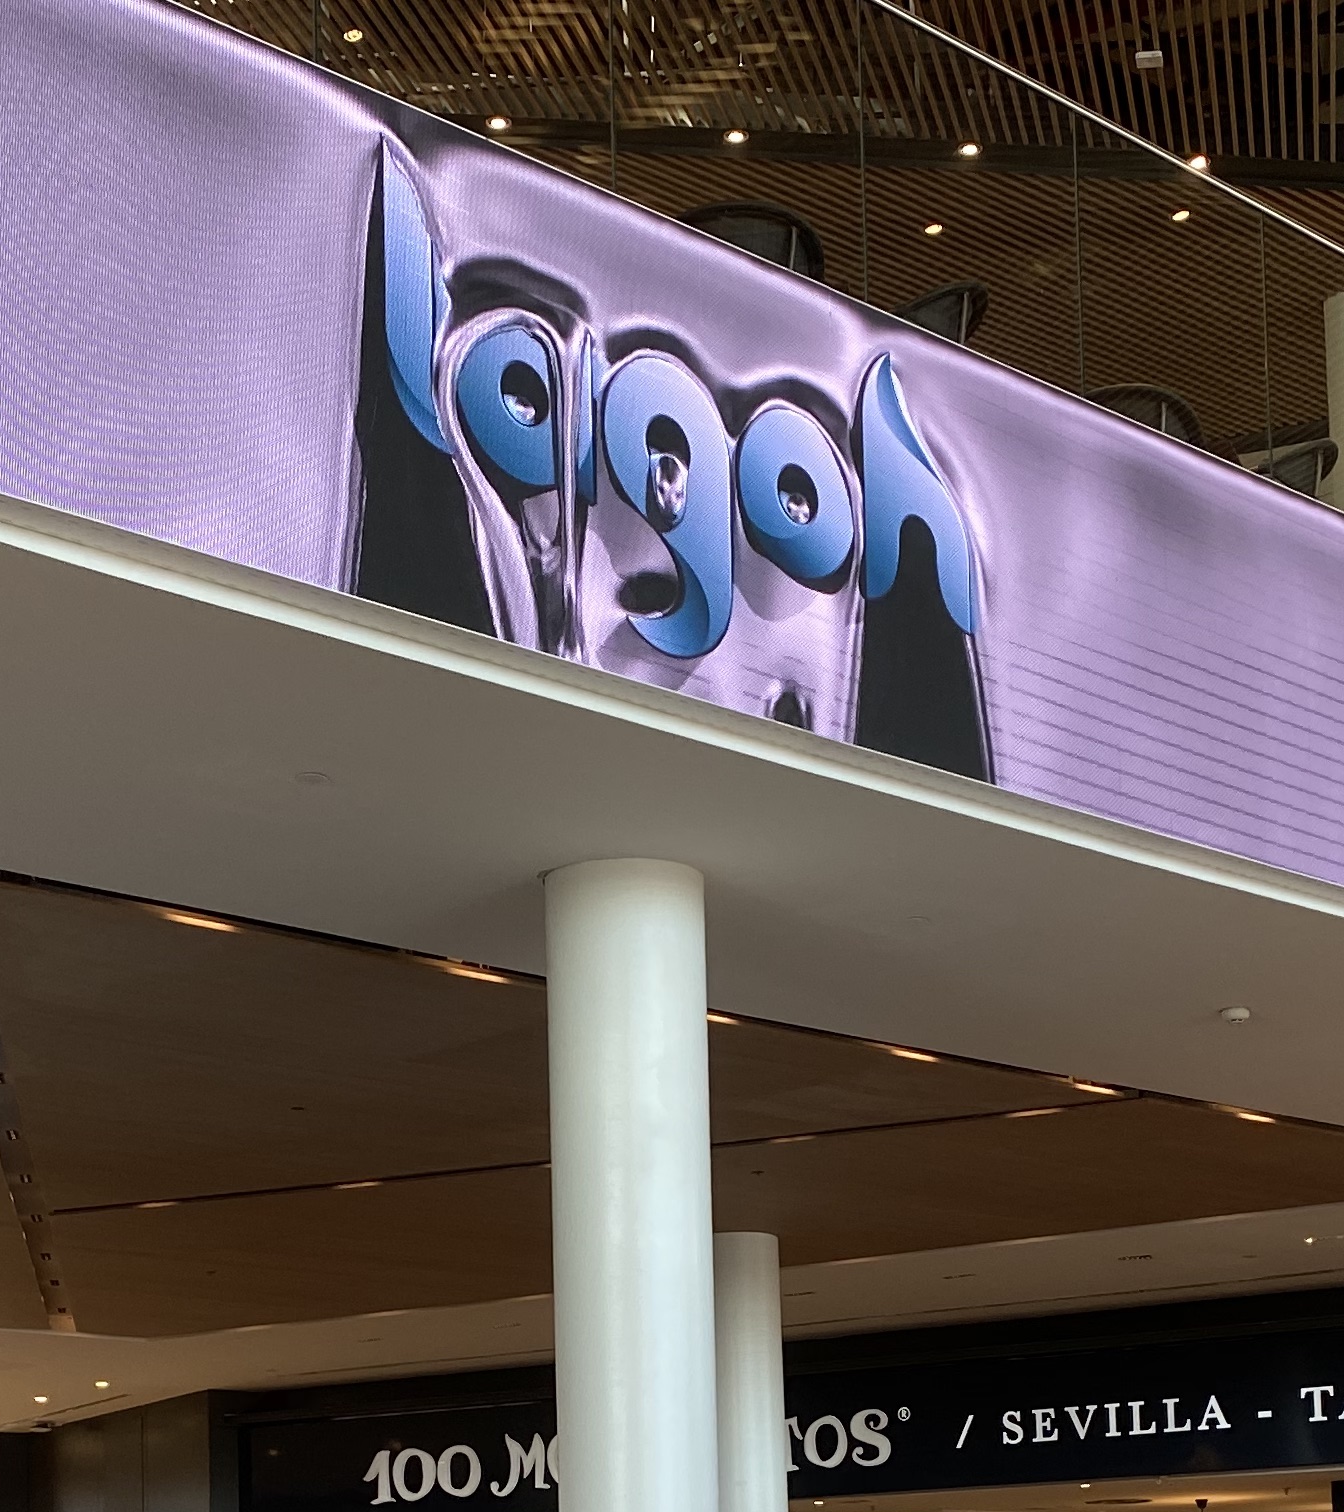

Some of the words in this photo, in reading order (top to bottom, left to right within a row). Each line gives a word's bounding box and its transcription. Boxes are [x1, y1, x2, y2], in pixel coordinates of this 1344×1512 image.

[382, 131, 975, 660] lagoh
[1001, 1395, 1232, 1446] SEVILLA
[362, 1444, 482, 1506] 100
